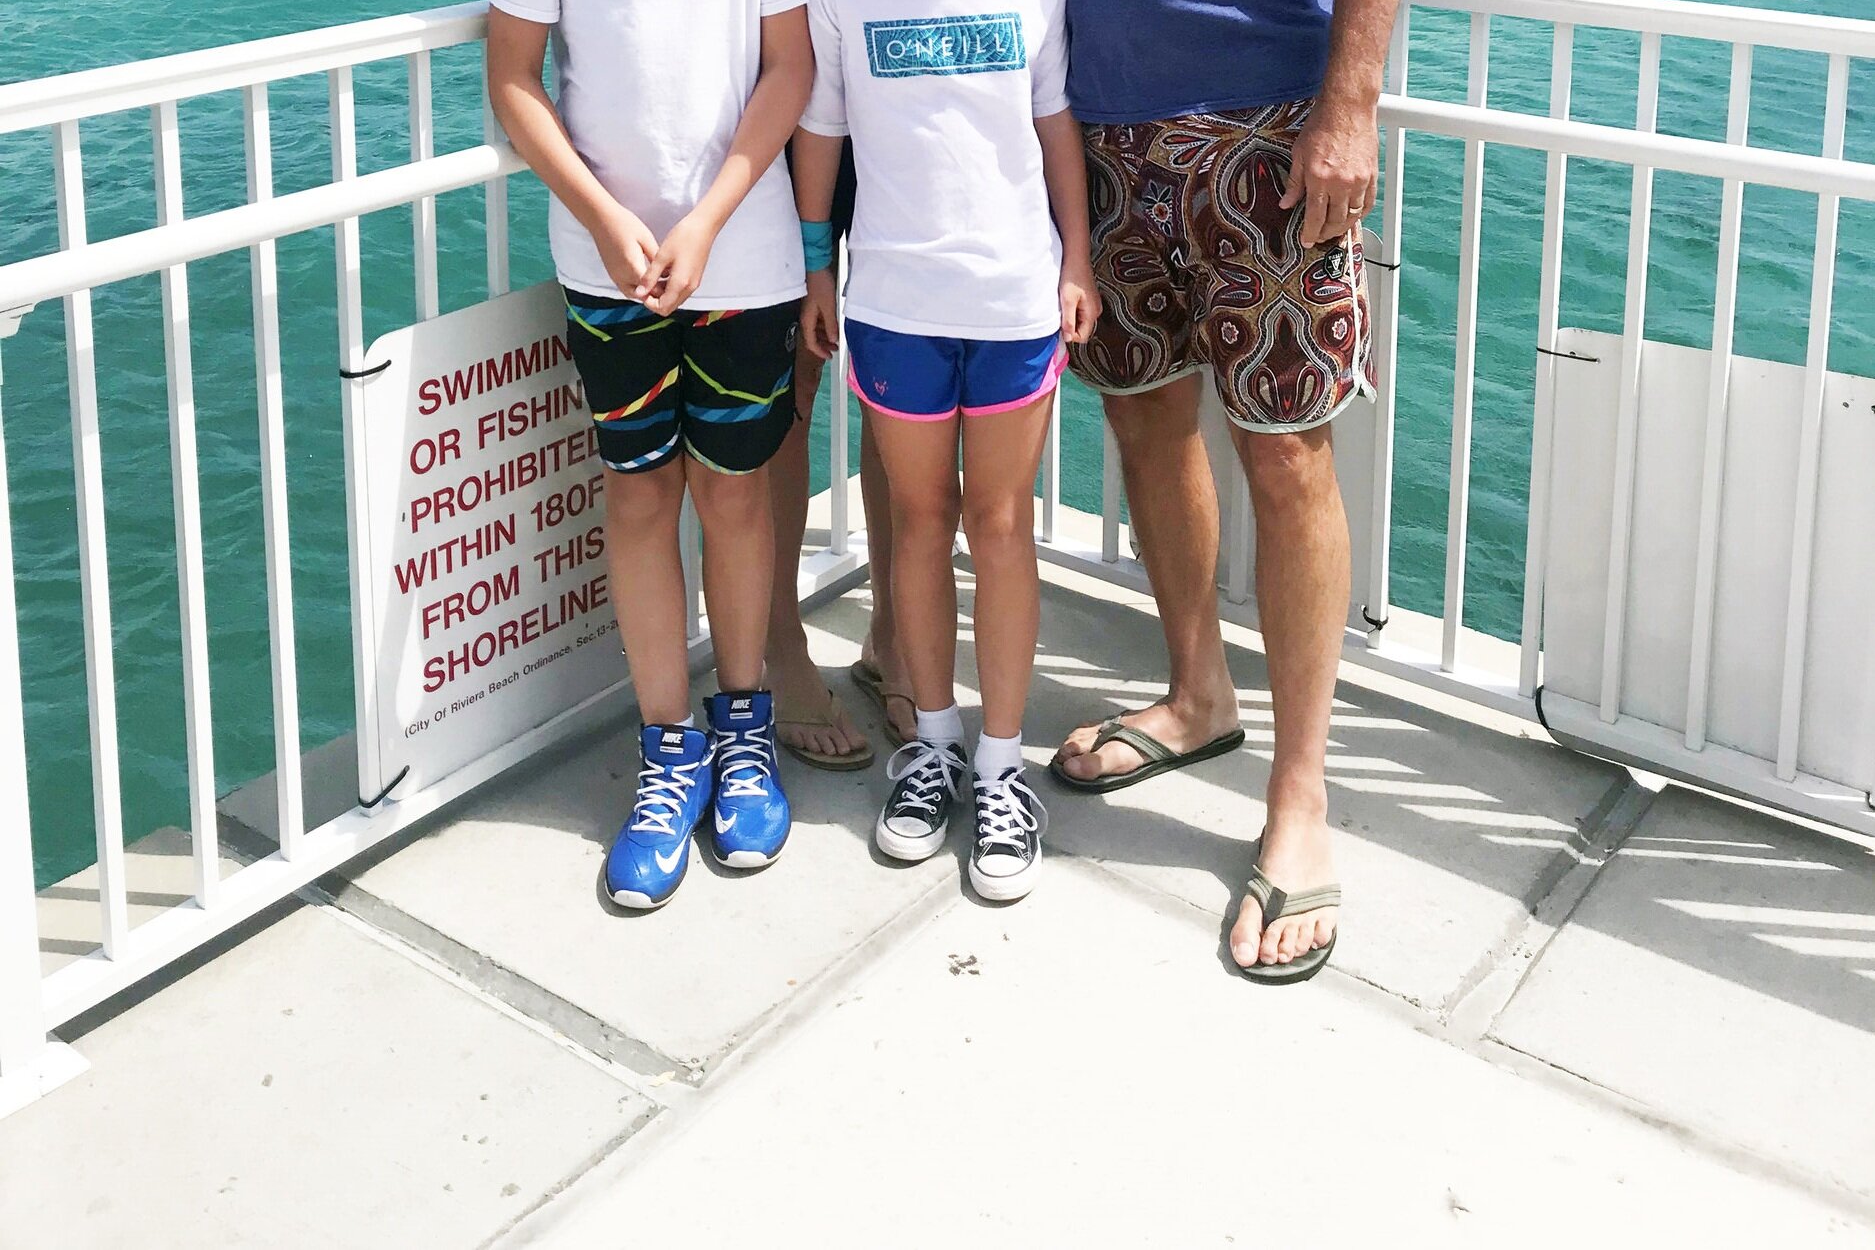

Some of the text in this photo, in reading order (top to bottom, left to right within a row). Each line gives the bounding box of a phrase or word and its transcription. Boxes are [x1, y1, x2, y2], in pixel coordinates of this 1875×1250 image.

[418, 334, 573, 417] SWIMMIN
[409, 378, 583, 476] OR FISHIN
[393, 512, 517, 595] WITHIN
[421, 525, 606, 640] FROM THIS
[421, 573, 609, 694] SHORELINE
[404, 718, 430, 739] (City
[434, 707, 447, 722] Of
[450, 689, 485, 714] Riviera
[488, 670, 520, 694] Beach
[661, 732, 684, 744] NIKE
[731, 699, 752, 709] NIKE
